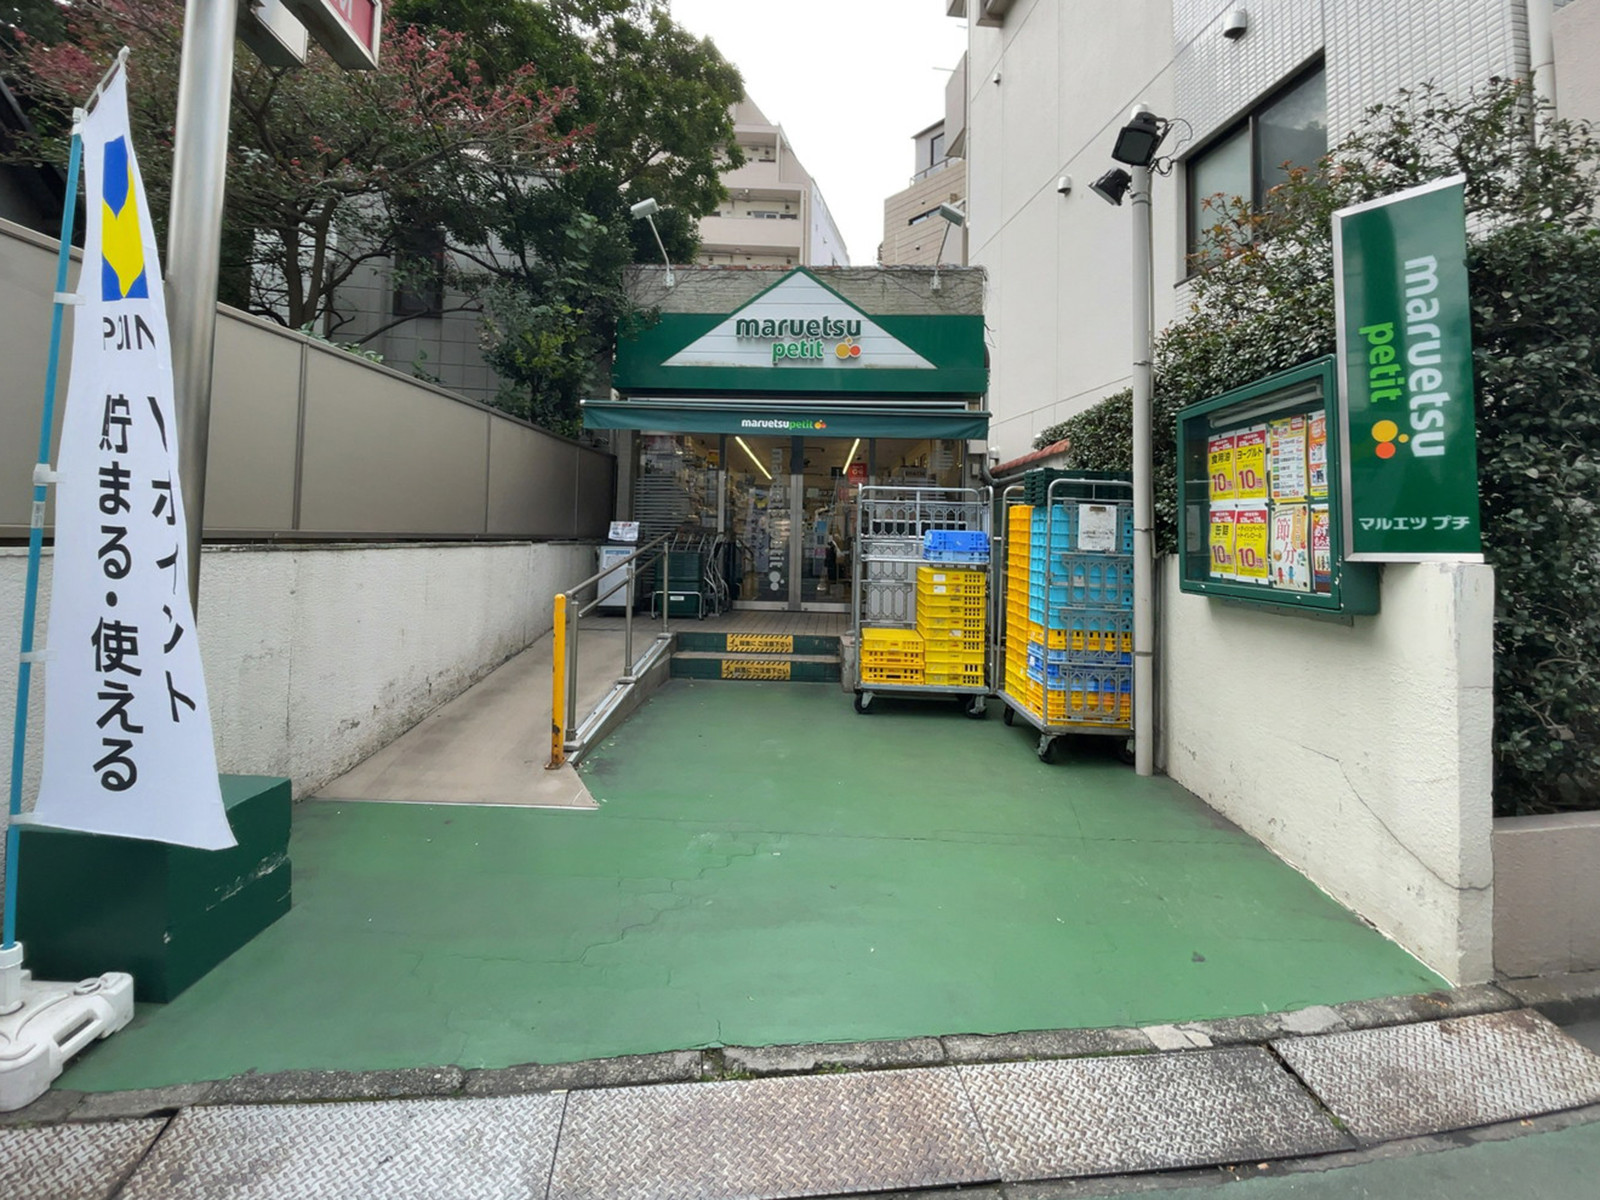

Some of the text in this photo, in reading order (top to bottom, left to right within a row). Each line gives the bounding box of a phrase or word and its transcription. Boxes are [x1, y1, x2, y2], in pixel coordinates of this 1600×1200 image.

[736, 315, 862, 337] maruetsu
[771, 339, 824, 361] petit
[1404, 254, 1451, 457] maruetsu
[1358, 322, 1406, 403] petit
[1236, 447, 1263, 460] ヨーグルト
[1358, 516, 1471, 531] マルエツ プチ
